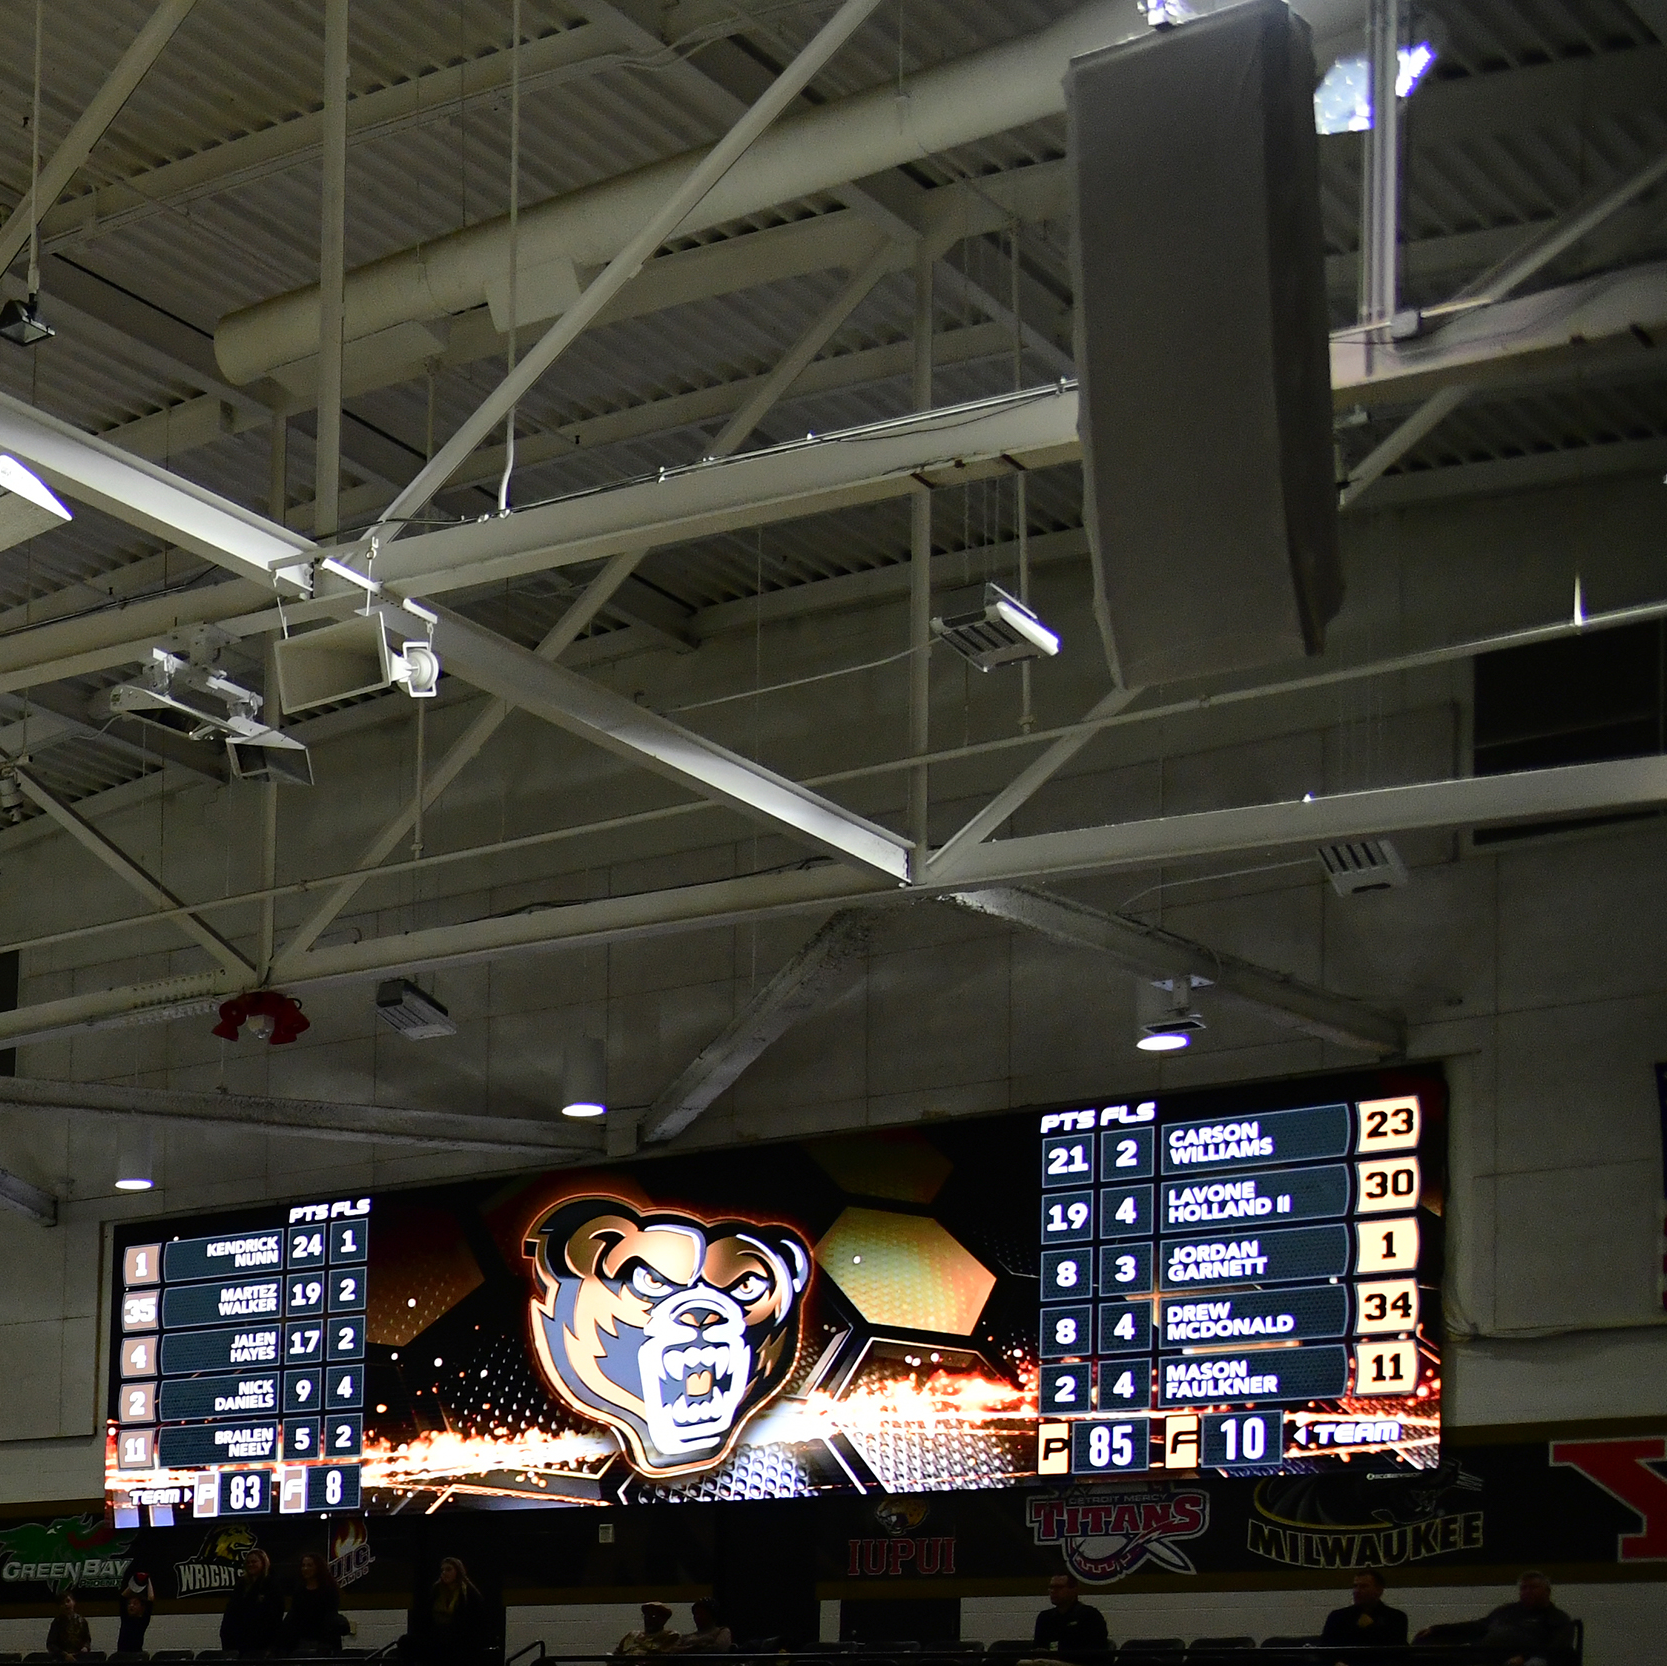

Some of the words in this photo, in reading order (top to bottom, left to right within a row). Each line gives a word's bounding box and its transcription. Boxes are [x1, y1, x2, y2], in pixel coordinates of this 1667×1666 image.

[1040, 1110, 1095, 1134] PTS
[1100, 1102, 1156, 1127] FLS
[1366, 1107, 1415, 1139] 23
[1169, 1121, 1260, 1149] CARSON
[1047, 1145, 1089, 1176] 21
[1114, 1139, 1139, 1168] 2
[1170, 1137, 1274, 1166] WILLIAMS
[1168, 1181, 1256, 1207] LAVONE
[1365, 1168, 1415, 1200] 30
[289, 1204, 329, 1224] PTS
[330, 1198, 371, 1218] FLS
[1046, 1203, 1089, 1232] 19
[1114, 1196, 1138, 1225] 4
[1168, 1197, 1272, 1225] HOLLAND
[1276, 1195, 1291, 1213] II
[206, 1235, 279, 1258] KENDRICK
[292, 1234, 322, 1259] 24
[341, 1230, 357, 1253] 1
[1168, 1240, 1259, 1266] JORDAN
[1381, 1231, 1397, 1260] 1
[135, 1253, 148, 1277] 1
[234, 1250, 279, 1268] NUNN
[1113, 1254, 1138, 1283] 3
[1167, 1256, 1268, 1283] GARNETT
[1055, 1260, 1079, 1289] 8
[220, 1283, 278, 1302] MARTEZ
[290, 1282, 321, 1306] 19
[338, 1279, 355, 1301] 2
[124, 1300, 156, 1323] 35
[218, 1298, 277, 1316] WALKER
[1167, 1301, 1231, 1324] DREW
[1363, 1291, 1412, 1322] 34
[338, 1327, 354, 1350] 2
[1054, 1317, 1078, 1345] 8
[1112, 1312, 1136, 1342] 4
[1166, 1314, 1295, 1342] MCDONALD
[230, 1332, 276, 1350] JALEN
[289, 1330, 321, 1354] 17
[130, 1346, 147, 1368] 4
[230, 1346, 276, 1363] HAYES
[1371, 1352, 1404, 1382] 11
[1112, 1370, 1135, 1399] 4
[1166, 1359, 1248, 1384] MASON
[239, 1380, 274, 1396] NICK
[295, 1379, 312, 1401] 9
[336, 1376, 353, 1398] 4
[1053, 1375, 1077, 1404] 2
[1166, 1374, 1278, 1400] FAULKNER
[129, 1391, 146, 1415] 2
[215, 1393, 274, 1412] DANIELS
[215, 1427, 274, 1445] BRAILEN
[294, 1428, 311, 1450] 5
[335, 1425, 352, 1448] 2
[1089, 1424, 1133, 1467] 85
[1220, 1417, 1265, 1461] 10
[1312, 1421, 1402, 1445] TEAM
[124, 1437, 146, 1462] 11
[228, 1442, 273, 1457] NEELY
[129, 1488, 180, 1505] TEAM
[229, 1475, 262, 1509] 83
[325, 1469, 343, 1505] 8
[1033, 1495, 1206, 1538] TITANS
[1247, 1511, 1484, 1569] MILWAUKEE
[848, 1537, 956, 1576] IUPUI
[179, 1564, 235, 1593] WRIGHT
